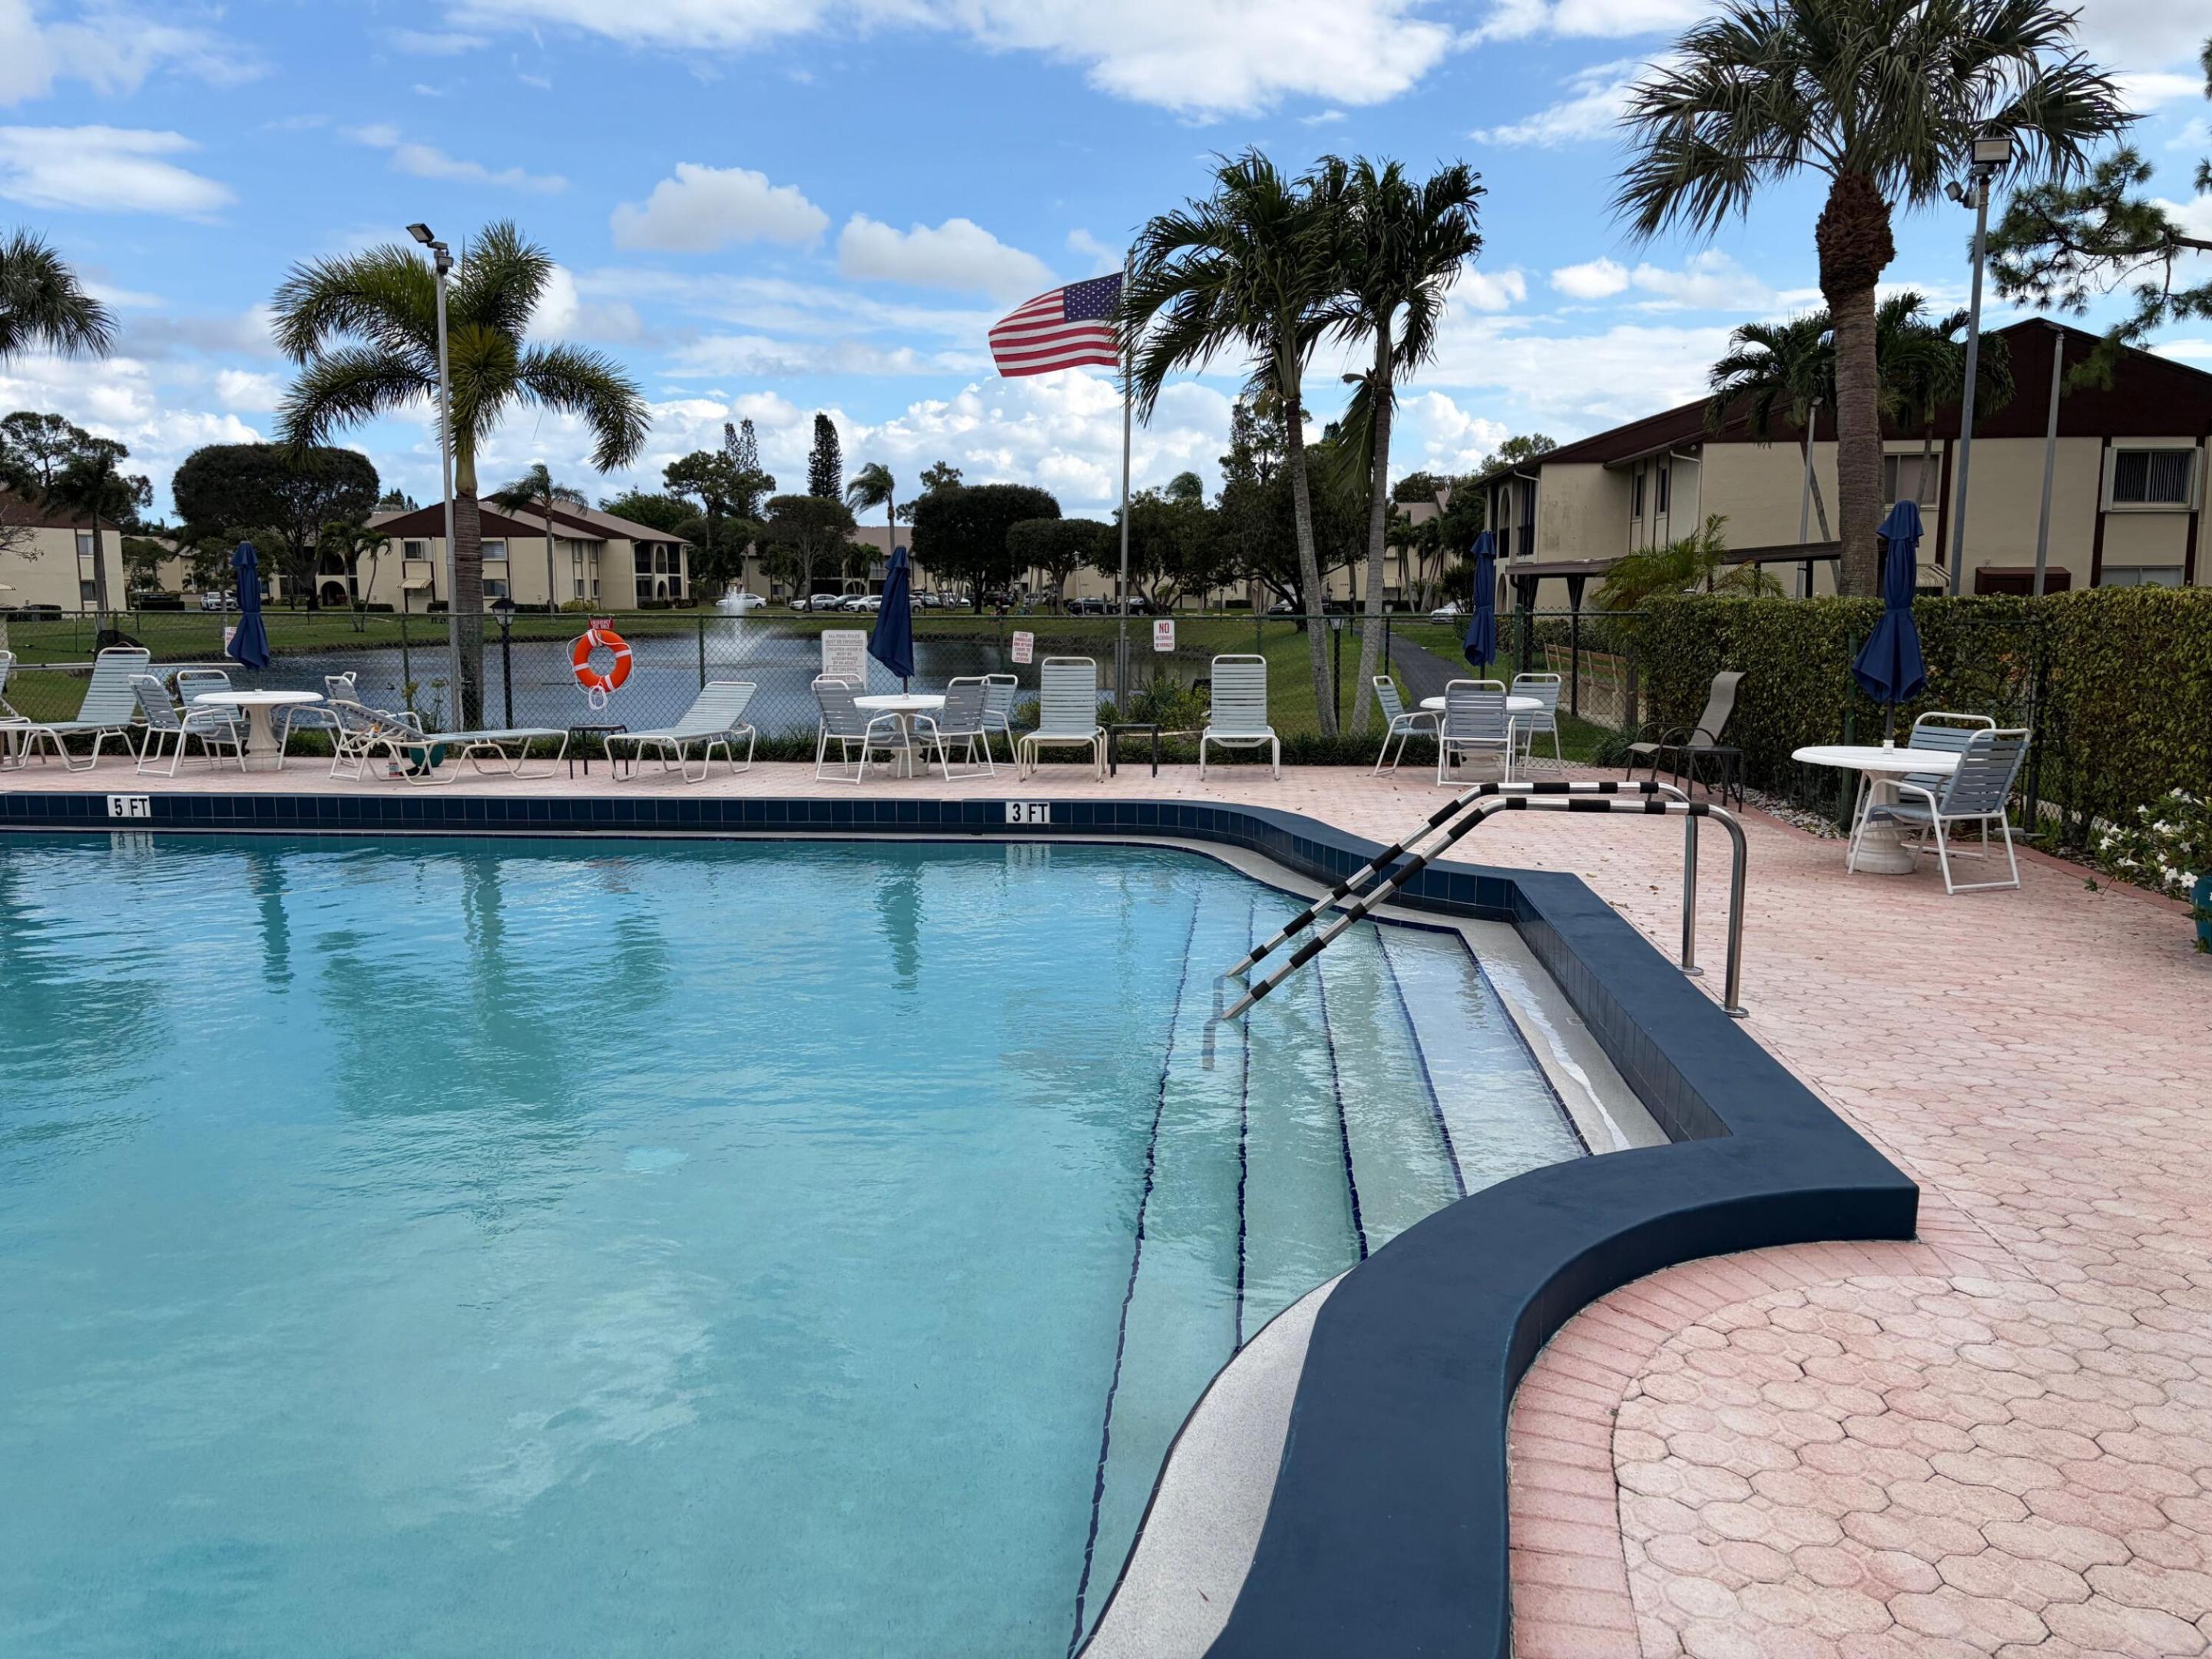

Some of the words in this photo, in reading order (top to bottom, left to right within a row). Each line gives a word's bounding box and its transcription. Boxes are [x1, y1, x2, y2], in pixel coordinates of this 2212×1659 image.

[1159, 623, 1170, 634] NO
[114, 798, 123, 816] 5
[129, 798, 147, 816] FT
[1012, 803, 1021, 822] 3
[1028, 803, 1048, 823] FT
